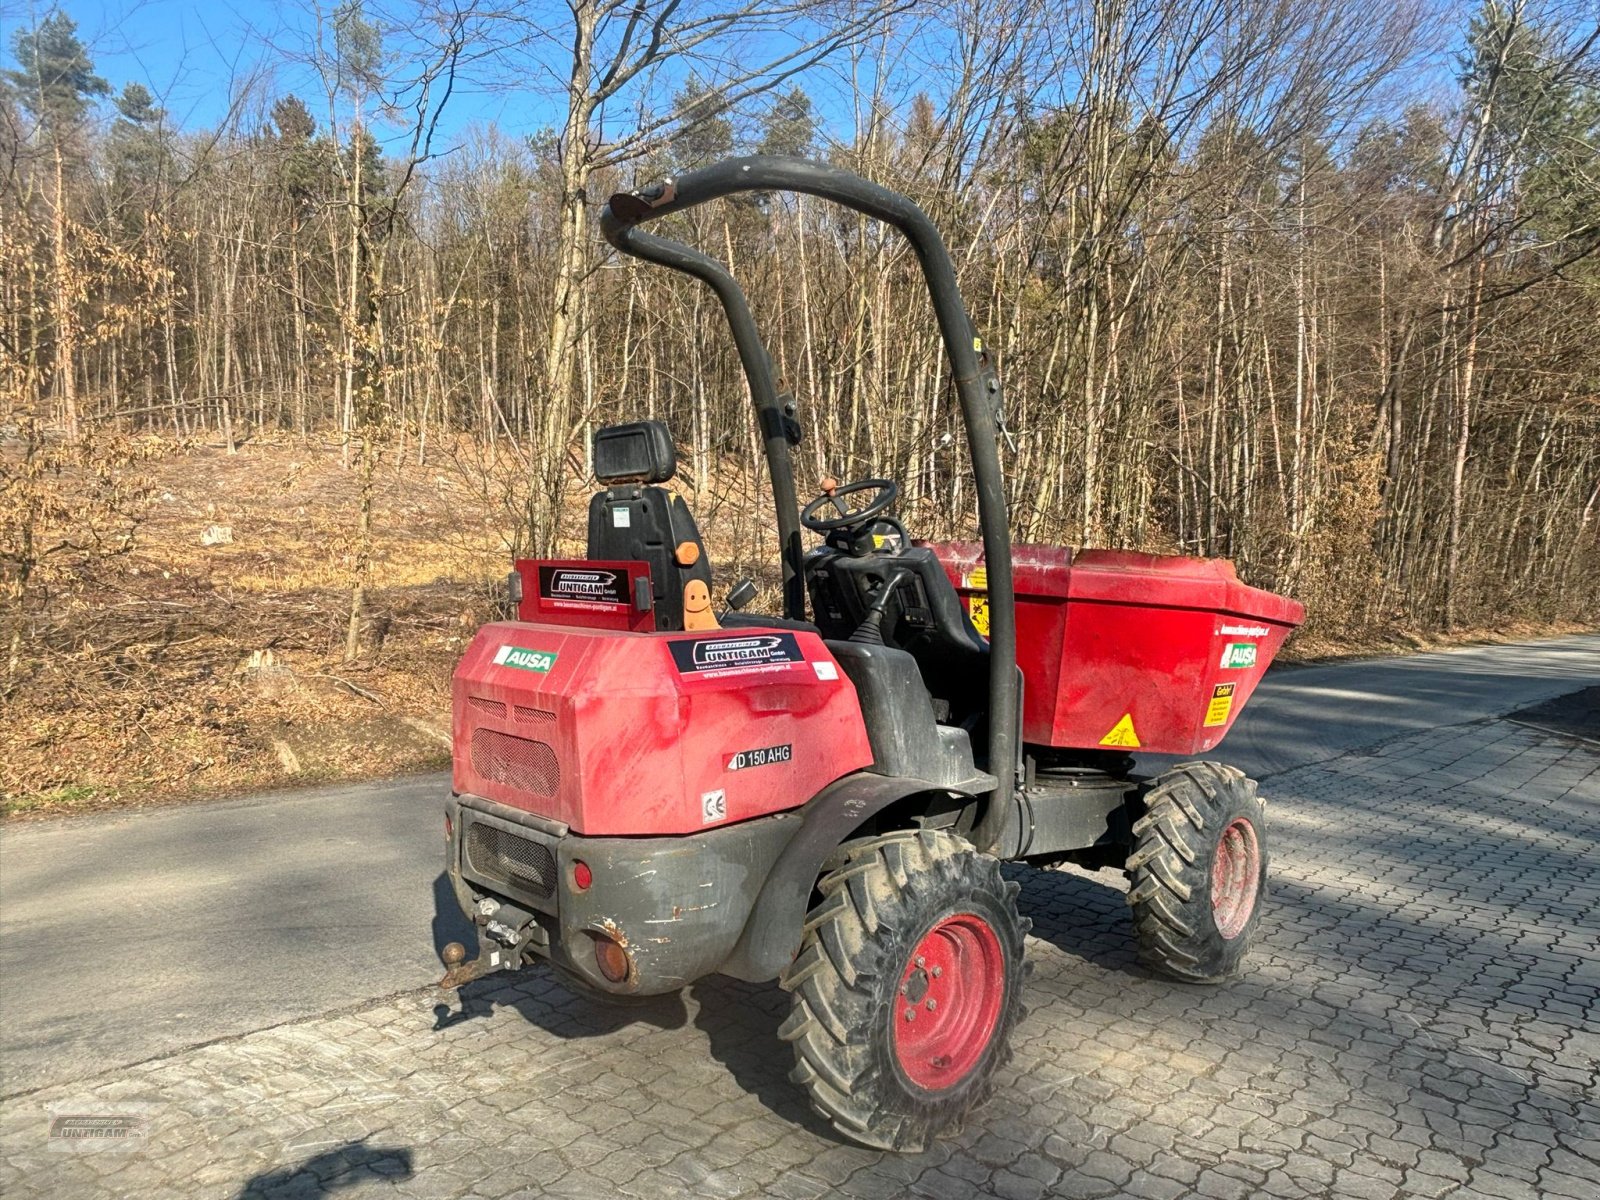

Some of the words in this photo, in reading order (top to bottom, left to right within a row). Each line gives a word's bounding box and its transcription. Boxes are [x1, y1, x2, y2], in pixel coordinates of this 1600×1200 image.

[506, 651, 551, 670] AUSA
[1229, 647, 1257, 665] AUSA
[738, 753, 746, 768] D
[748, 751, 765, 766] 150
[768, 746, 790, 763] AHG
